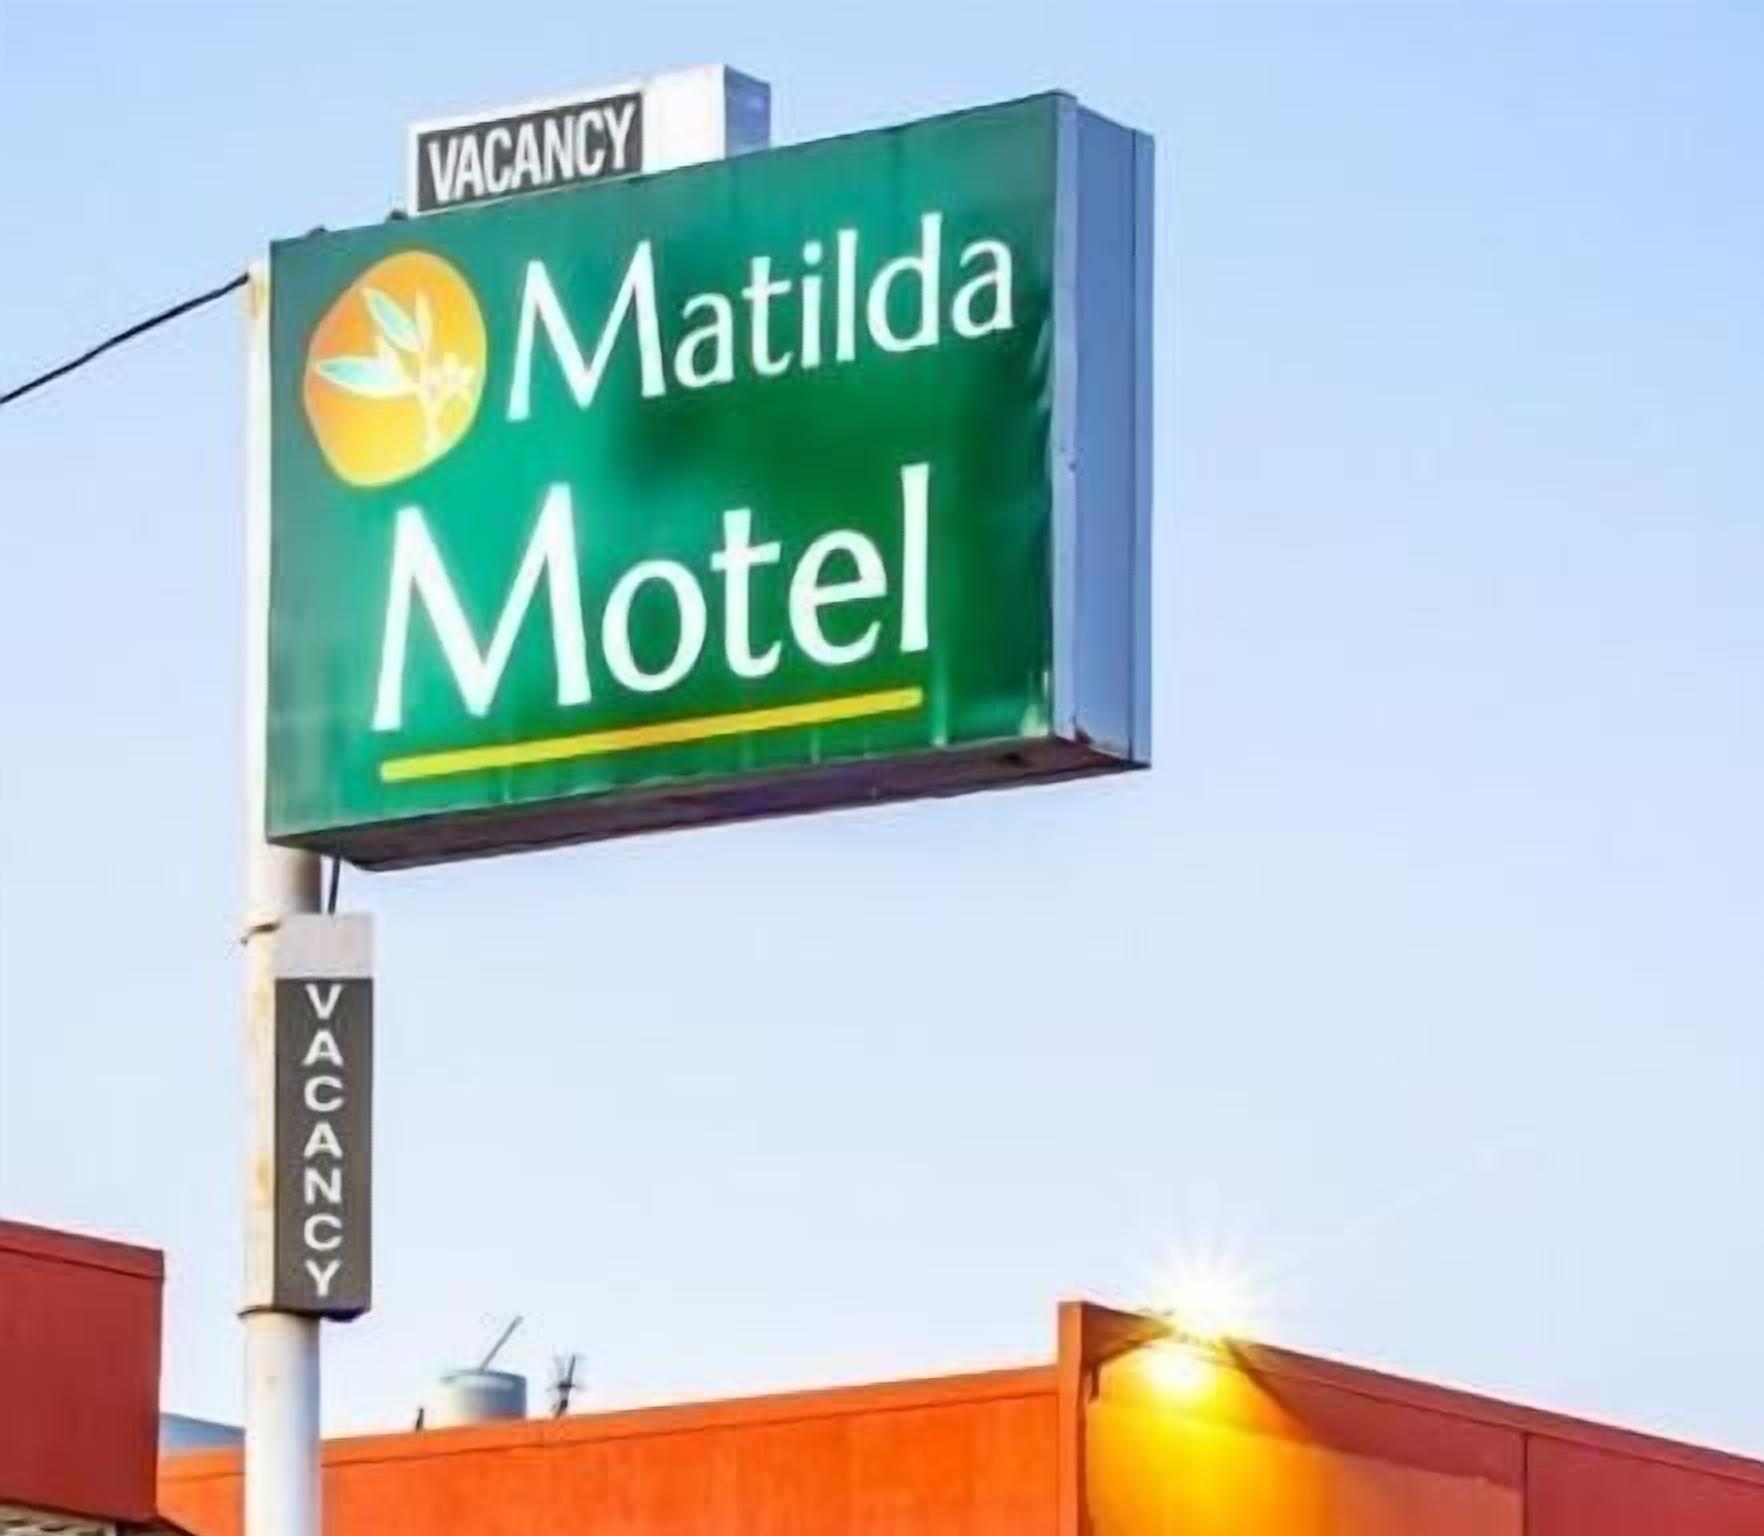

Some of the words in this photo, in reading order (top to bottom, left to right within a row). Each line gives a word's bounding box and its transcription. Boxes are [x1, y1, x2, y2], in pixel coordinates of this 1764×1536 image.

[428, 102, 636, 204] VACANCY
[506, 212, 1015, 422] Matilda
[371, 462, 931, 731] Motel
[303, 984, 344, 1298] VACANCY
